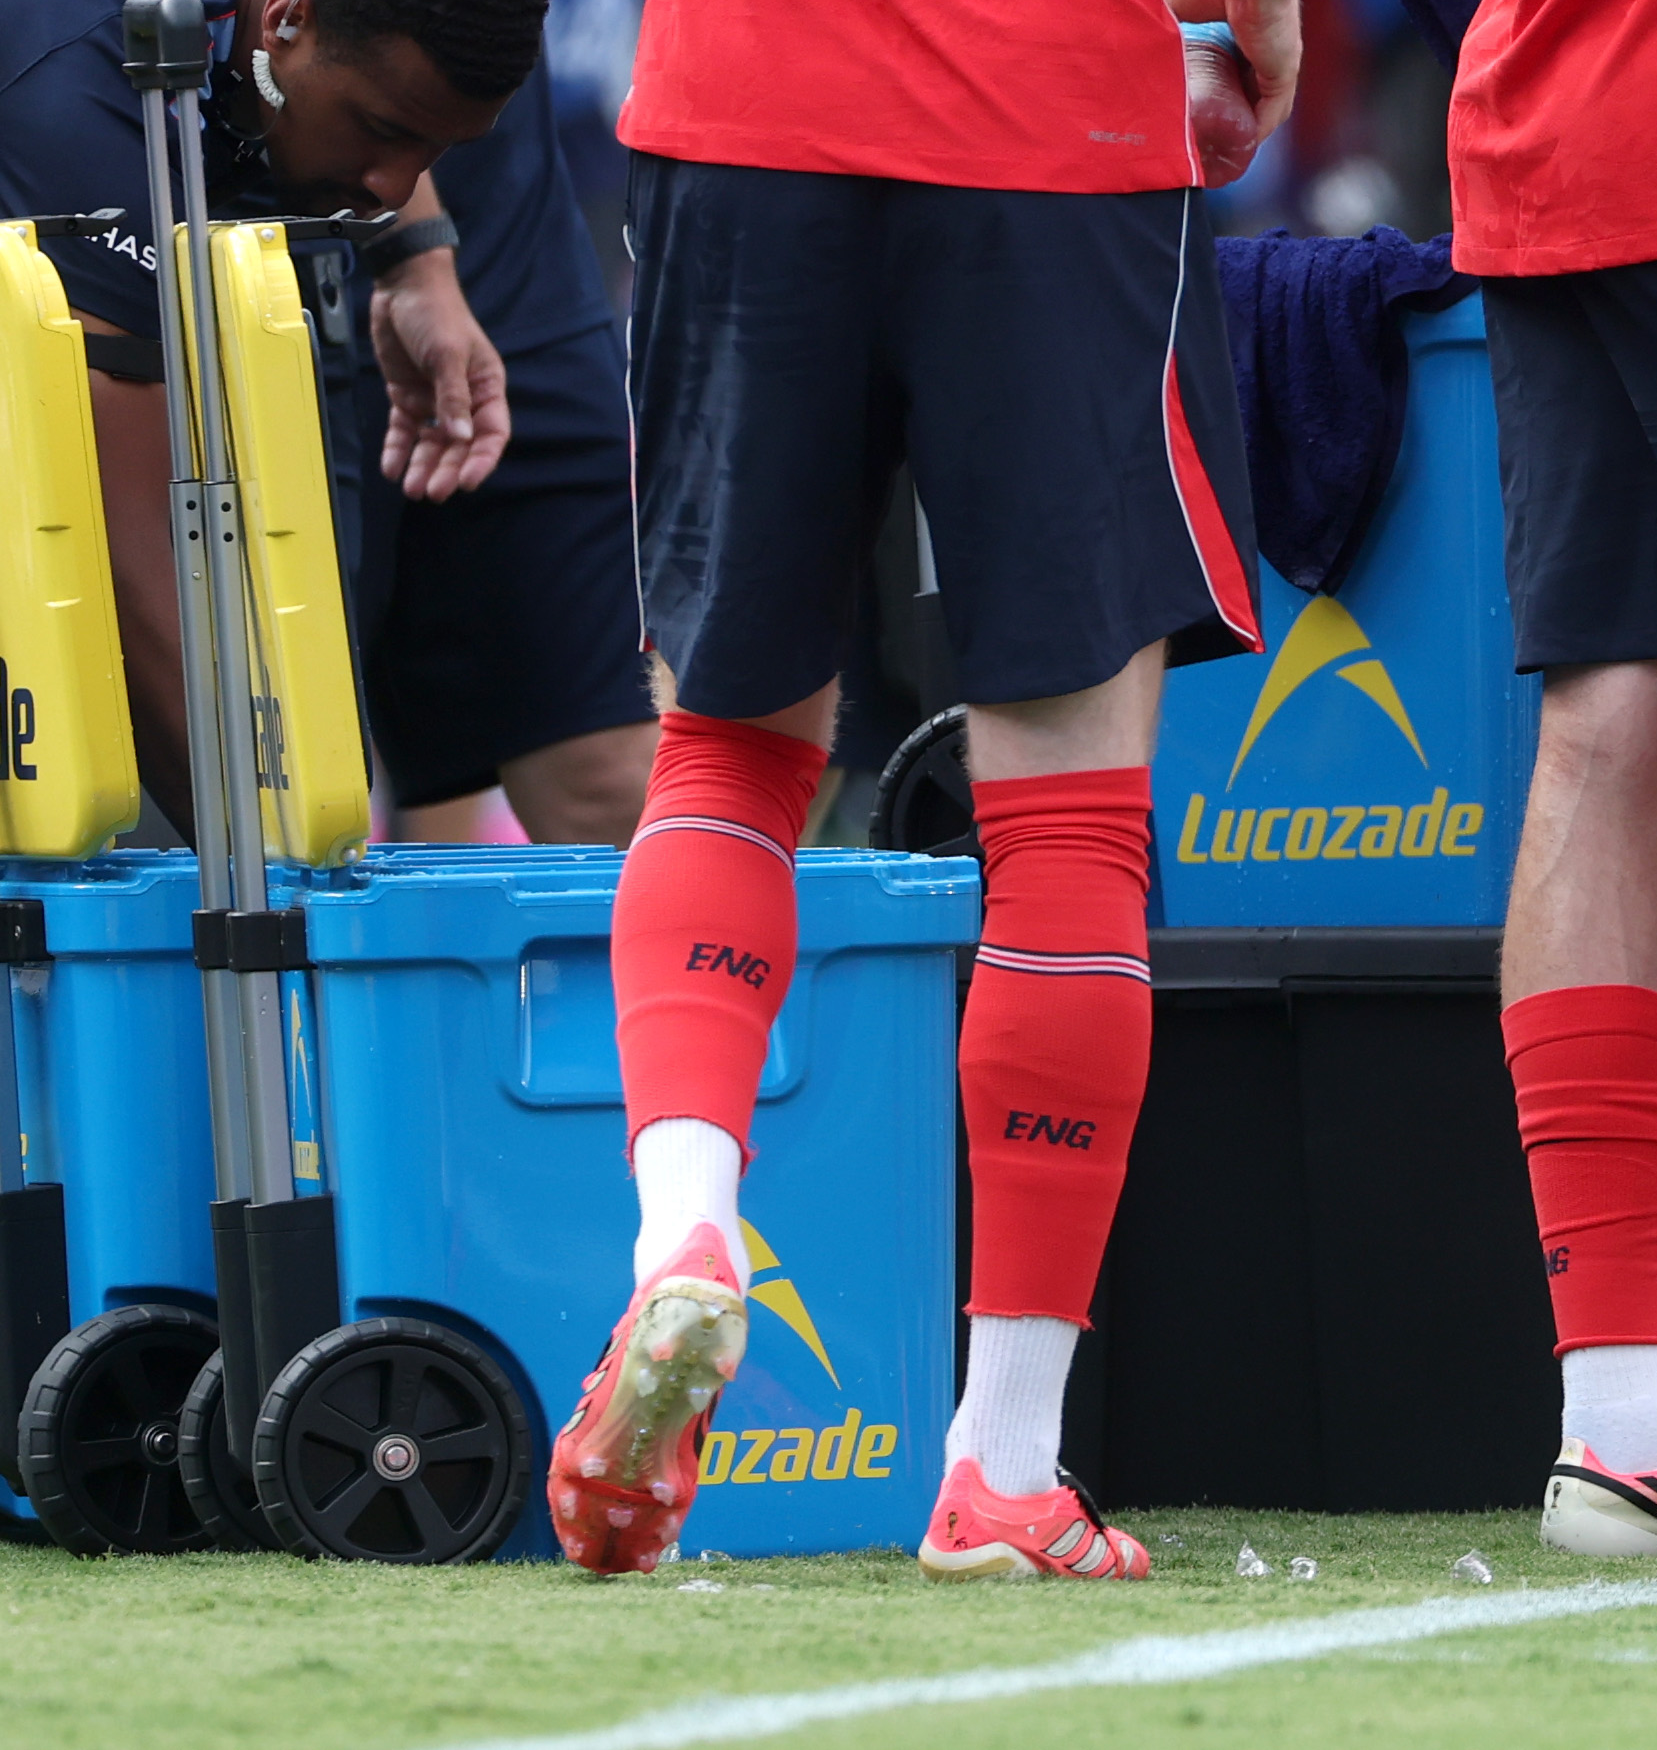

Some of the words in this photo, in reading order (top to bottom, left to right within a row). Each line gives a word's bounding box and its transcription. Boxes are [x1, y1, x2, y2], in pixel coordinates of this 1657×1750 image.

[1177, 786, 1484, 863] Lucozade
[685, 943, 772, 991] ENG
[1004, 1110, 1097, 1149] ENG
